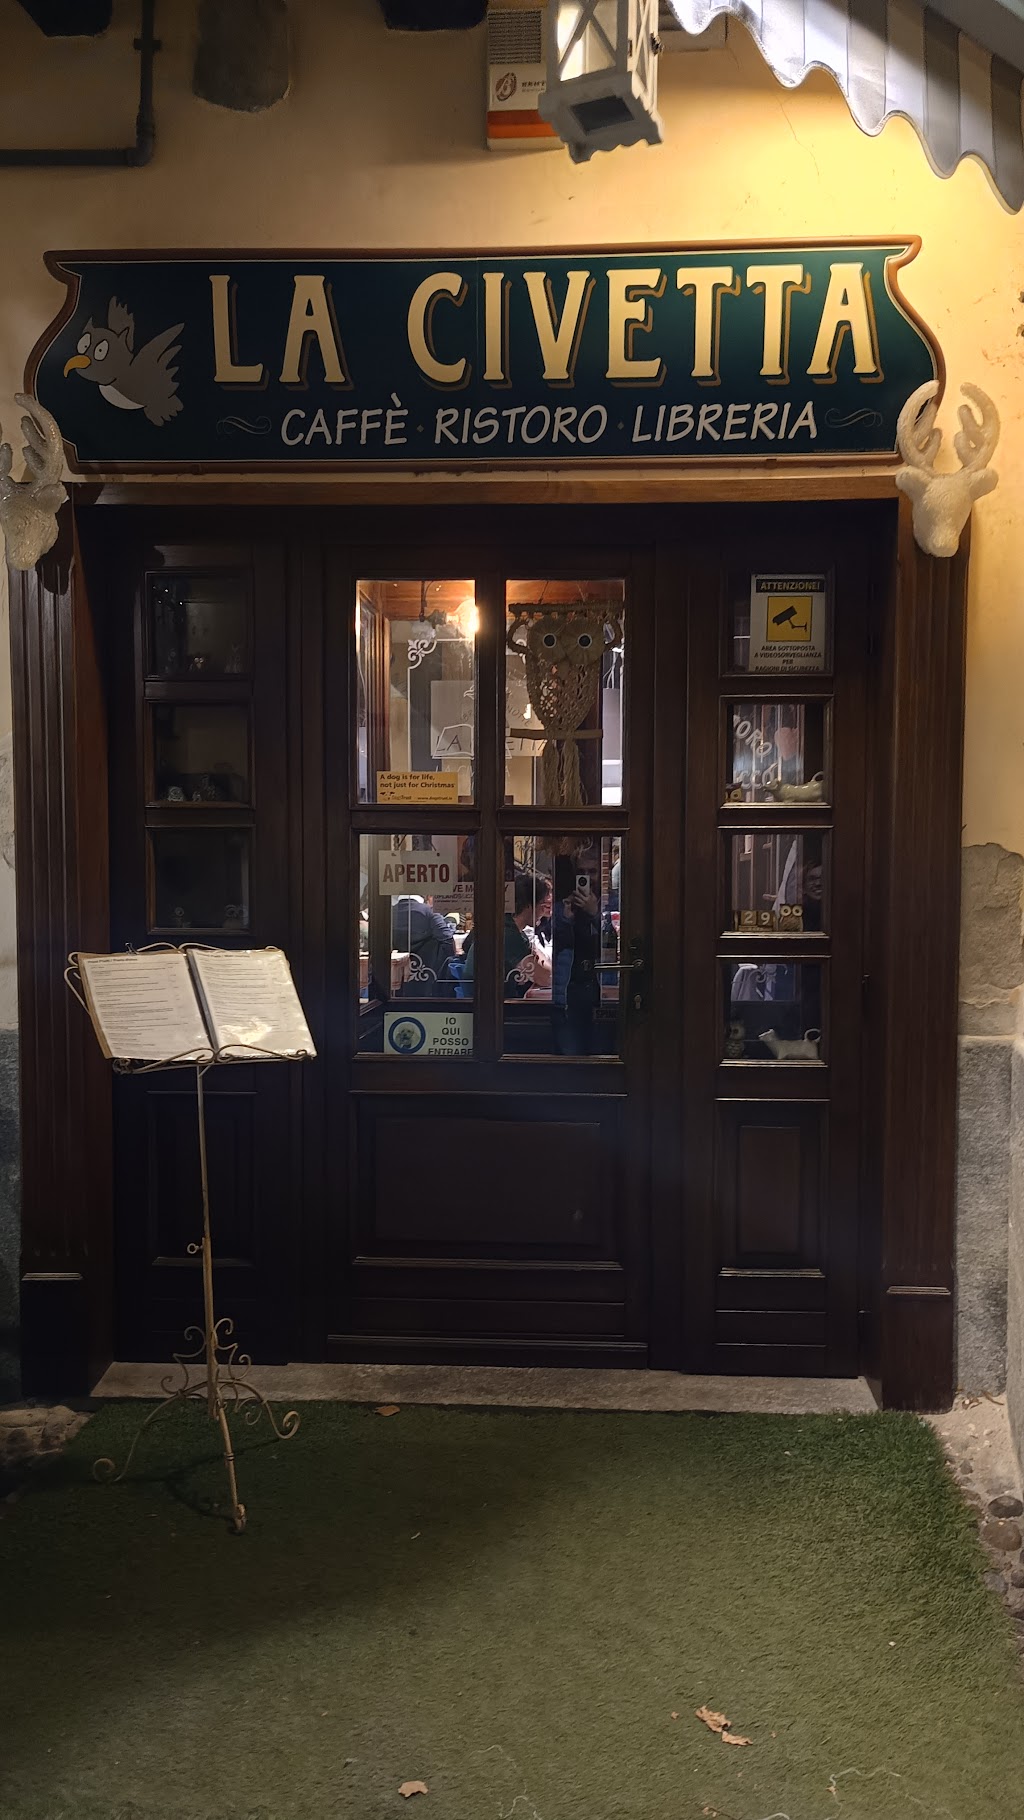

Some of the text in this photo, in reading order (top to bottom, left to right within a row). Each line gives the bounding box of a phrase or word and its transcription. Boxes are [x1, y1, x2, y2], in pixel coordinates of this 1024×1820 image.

[209, 263, 882, 389] LA CIVETTA
[280, 392, 818, 446] CAFFÈ RISTORO LIBRERIA
[760, 580, 820, 591] ATTENZIONE!
[387, 773, 400, 781] dog
[421, 773, 435, 781] life,
[382, 863, 450, 883] APERTO
[445, 1017, 457, 1025] IO
[441, 1027, 460, 1036] QUI
[432, 1037, 470, 1046] POSSO
